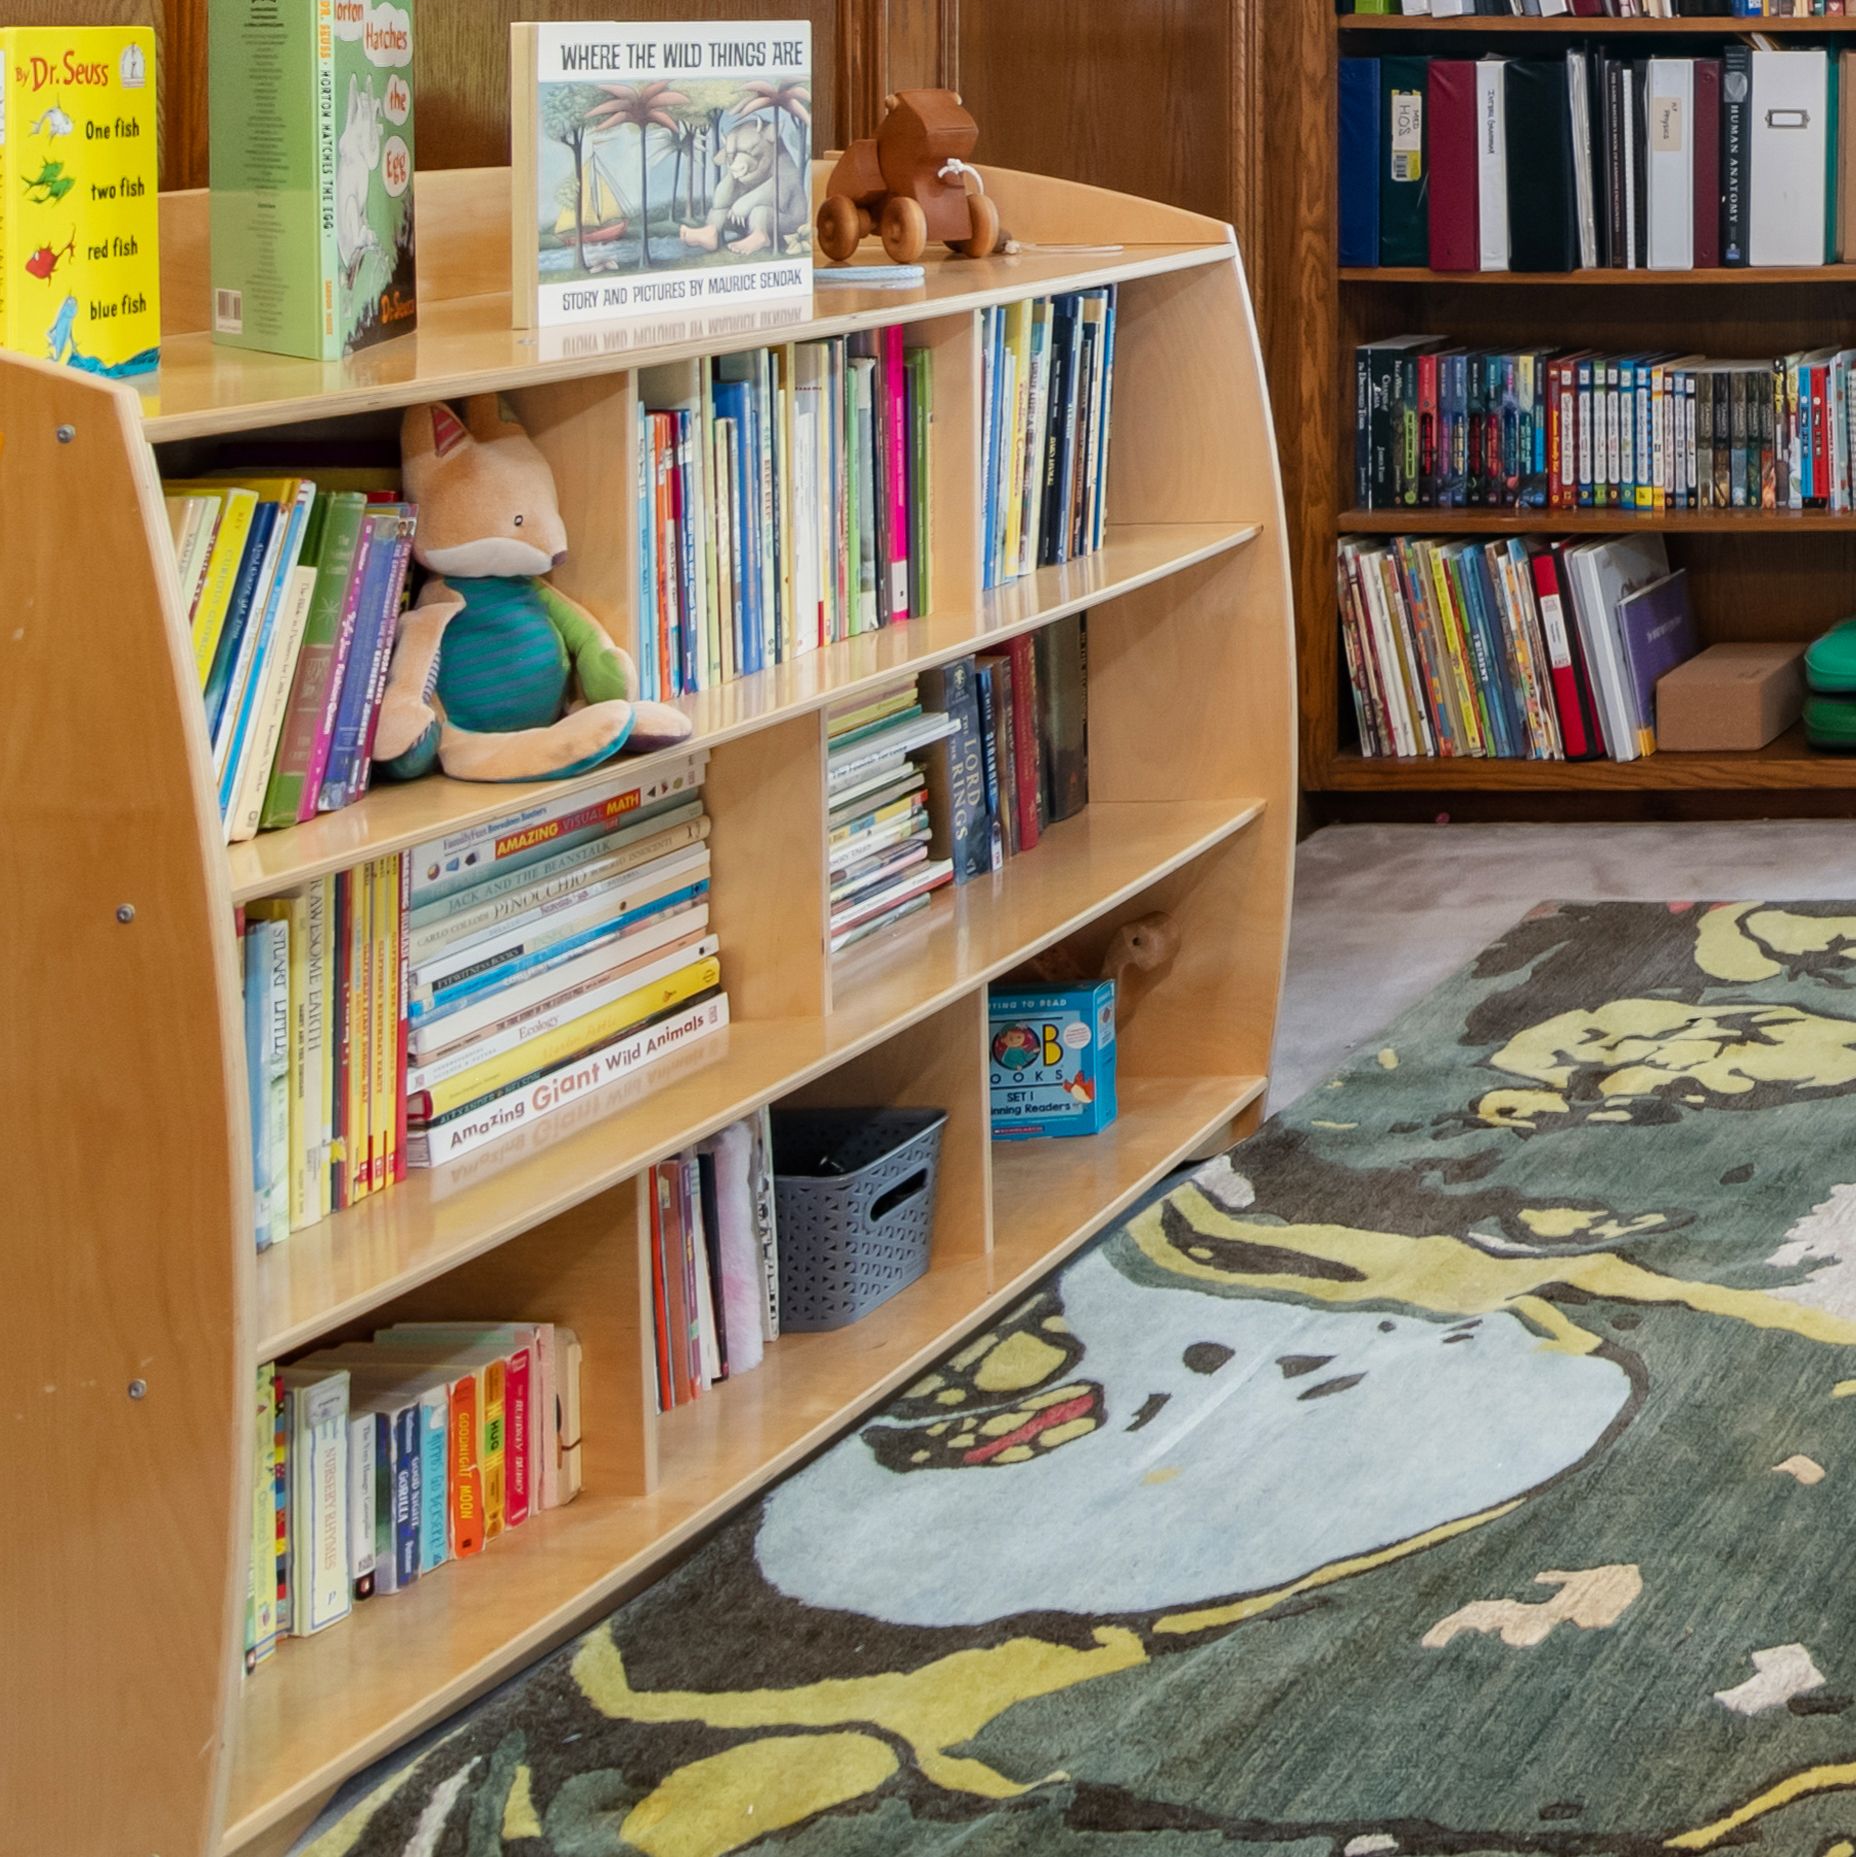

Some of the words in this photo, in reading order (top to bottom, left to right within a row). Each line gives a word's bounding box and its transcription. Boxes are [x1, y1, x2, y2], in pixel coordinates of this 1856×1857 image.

[366, 22, 408, 50] Hatches
[16, 67, 29, 87] By
[31, 57, 60, 91] Dr.
[63, 50, 109, 86] Seuss
[561, 44, 621, 70] WHERE
[627, 43, 656, 69] THE
[663, 43, 702, 69] WILD
[709, 42, 766, 67] THINGS
[773, 41, 803, 66] ARE
[320, 70, 334, 118] HORTON
[390, 85, 406, 111] the
[85, 120, 110, 140] One
[115, 117, 140, 138] fish
[1399, 105, 1411, 136] HOS
[1730, 104, 1740, 153] HUMAN
[321, 124, 335, 180] HATCHES
[386, 151, 407, 185] Egg
[91, 183, 116, 201] two
[120, 177, 145, 198] fish
[322, 181, 335, 203] THE
[1729, 158, 1740, 223] ANATOMY
[322, 206, 335, 231] EGG
[88, 240, 108, 260] red
[113, 236, 138, 257] fish
[90, 300, 118, 320] blue
[122, 294, 147, 316] fish
[563, 293, 599, 311] STORY
[603, 287, 628, 306] AND
[633, 280, 686, 304] PICTURES
[690, 279, 704, 298] BY
[708, 273, 756, 294] MAURICE
[760, 269, 802, 290] SENDAK
[964, 738, 981, 806] LORD
[951, 761, 969, 841] RINGS
[497, 822, 558, 856] AMAZING
[562, 808, 603, 831] VISUAL
[606, 792, 639, 815] MATH
[449, 895, 478, 914] JACK
[486, 879, 512, 896] AND
[517, 868, 537, 882] THE
[544, 842, 611, 874] BEANSTALK
[494, 871, 587, 918] PINOCCHIO
[273, 929, 287, 987] STUART
[309, 895, 324, 985] AWESOME
[519, 1015, 560, 1041] Ecology
[450, 1101, 525, 1148] Amazing
[532, 1064, 599, 1112] Giant
[605, 1042, 641, 1071] Wild
[646, 1013, 704, 1055] Animals
[990, 1069, 1063, 1084] OOKS
[1007, 1092, 1027, 1103] SET
[363, 1425, 371, 1442] The
[458, 1412, 472, 1478] GOODNIGHT
[490, 1420, 500, 1451] HUG
[324, 1447, 337, 1511] NURSERY
[411, 1456, 420, 1489] GOOD
[397, 1470, 409, 1523] GORILLA
[460, 1485, 473, 1519] MOON
[324, 1514, 337, 1570] RHYMES
